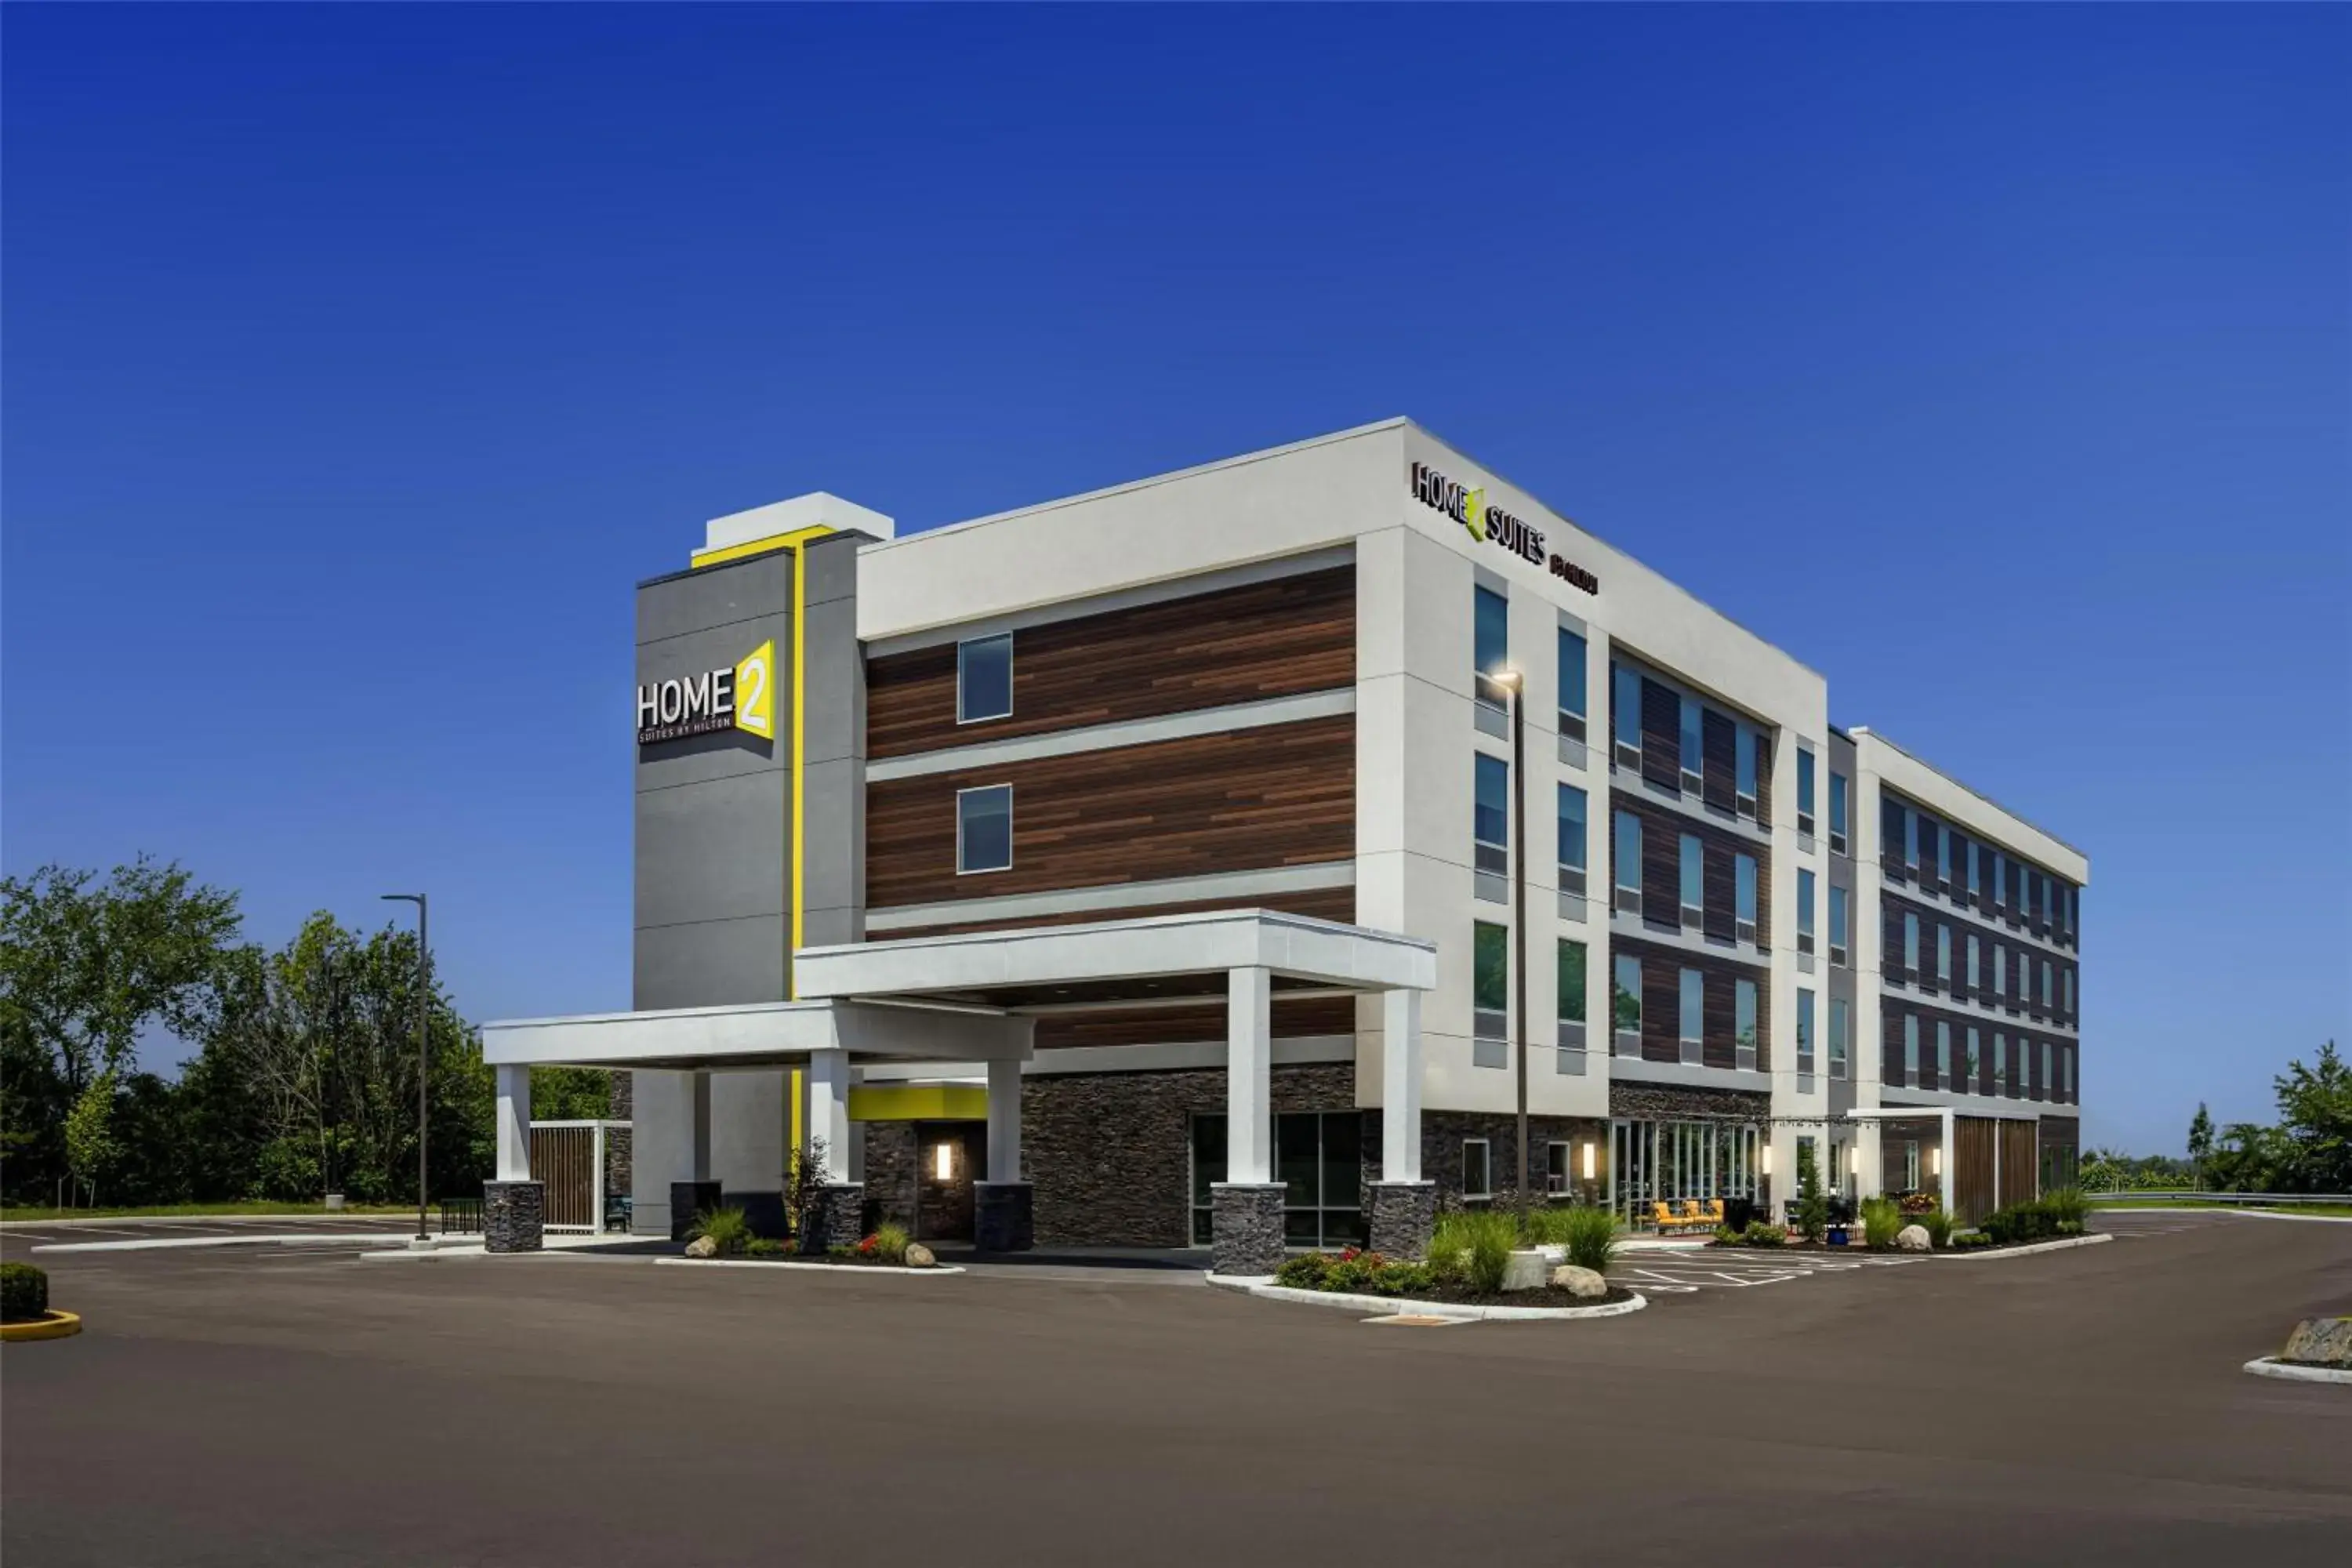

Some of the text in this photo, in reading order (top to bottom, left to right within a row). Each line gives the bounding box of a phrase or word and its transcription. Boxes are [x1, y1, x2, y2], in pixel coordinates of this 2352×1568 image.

[1412, 462, 1468, 524] HOME
[1486, 506, 1546, 565] SUITES
[637, 658, 767, 729] HOME 2
[639, 729, 674, 743] SUITES
[694, 717, 730, 733] HILTON
